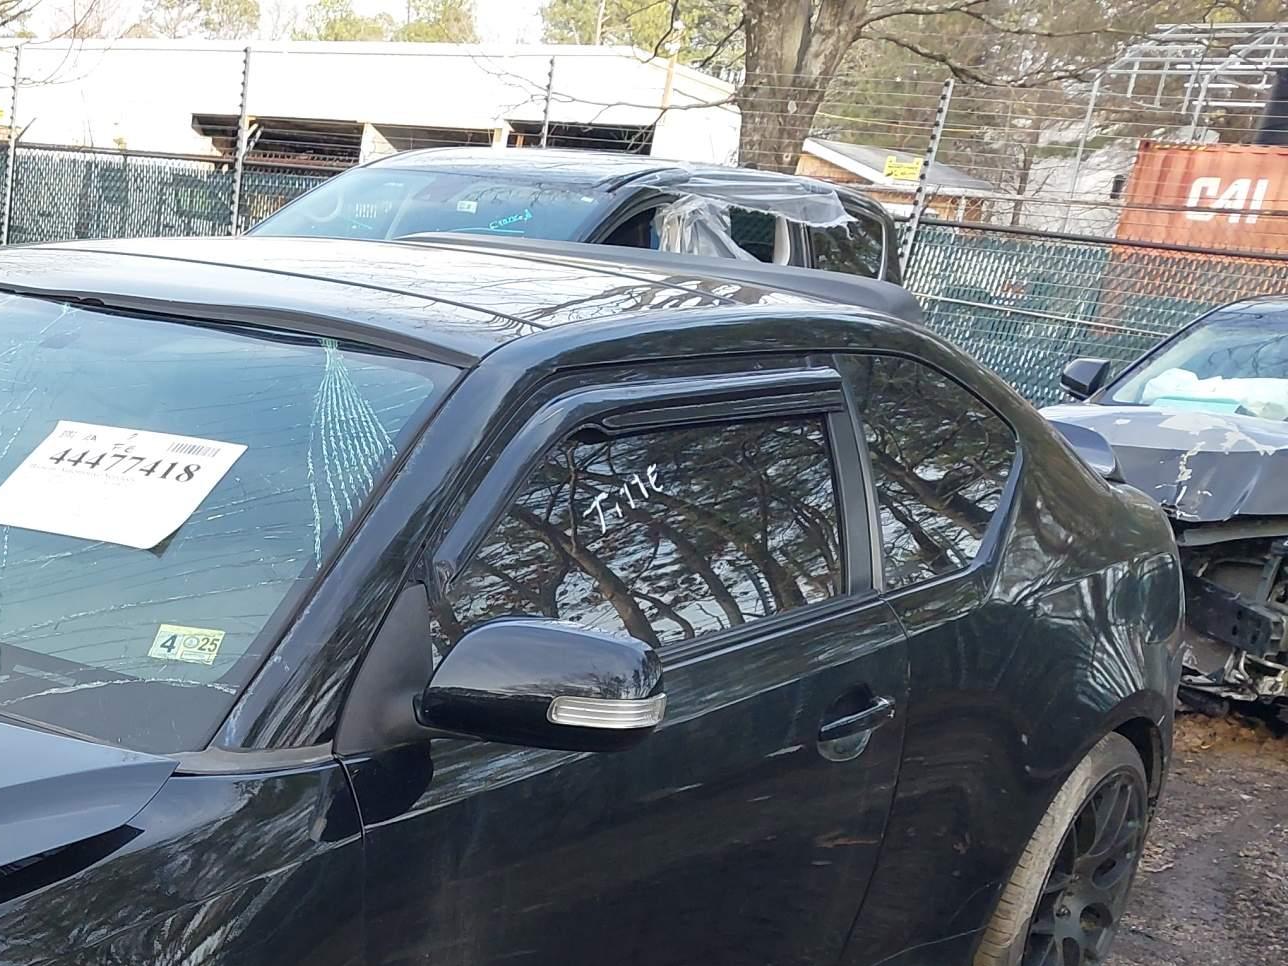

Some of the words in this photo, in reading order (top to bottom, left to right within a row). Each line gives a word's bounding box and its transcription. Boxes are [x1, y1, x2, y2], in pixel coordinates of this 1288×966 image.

[1184, 176, 1270, 225] CAI
[49, 447, 202, 483] 44477418
[160, 634, 178, 653] 4
[198, 637, 220, 653] 25
